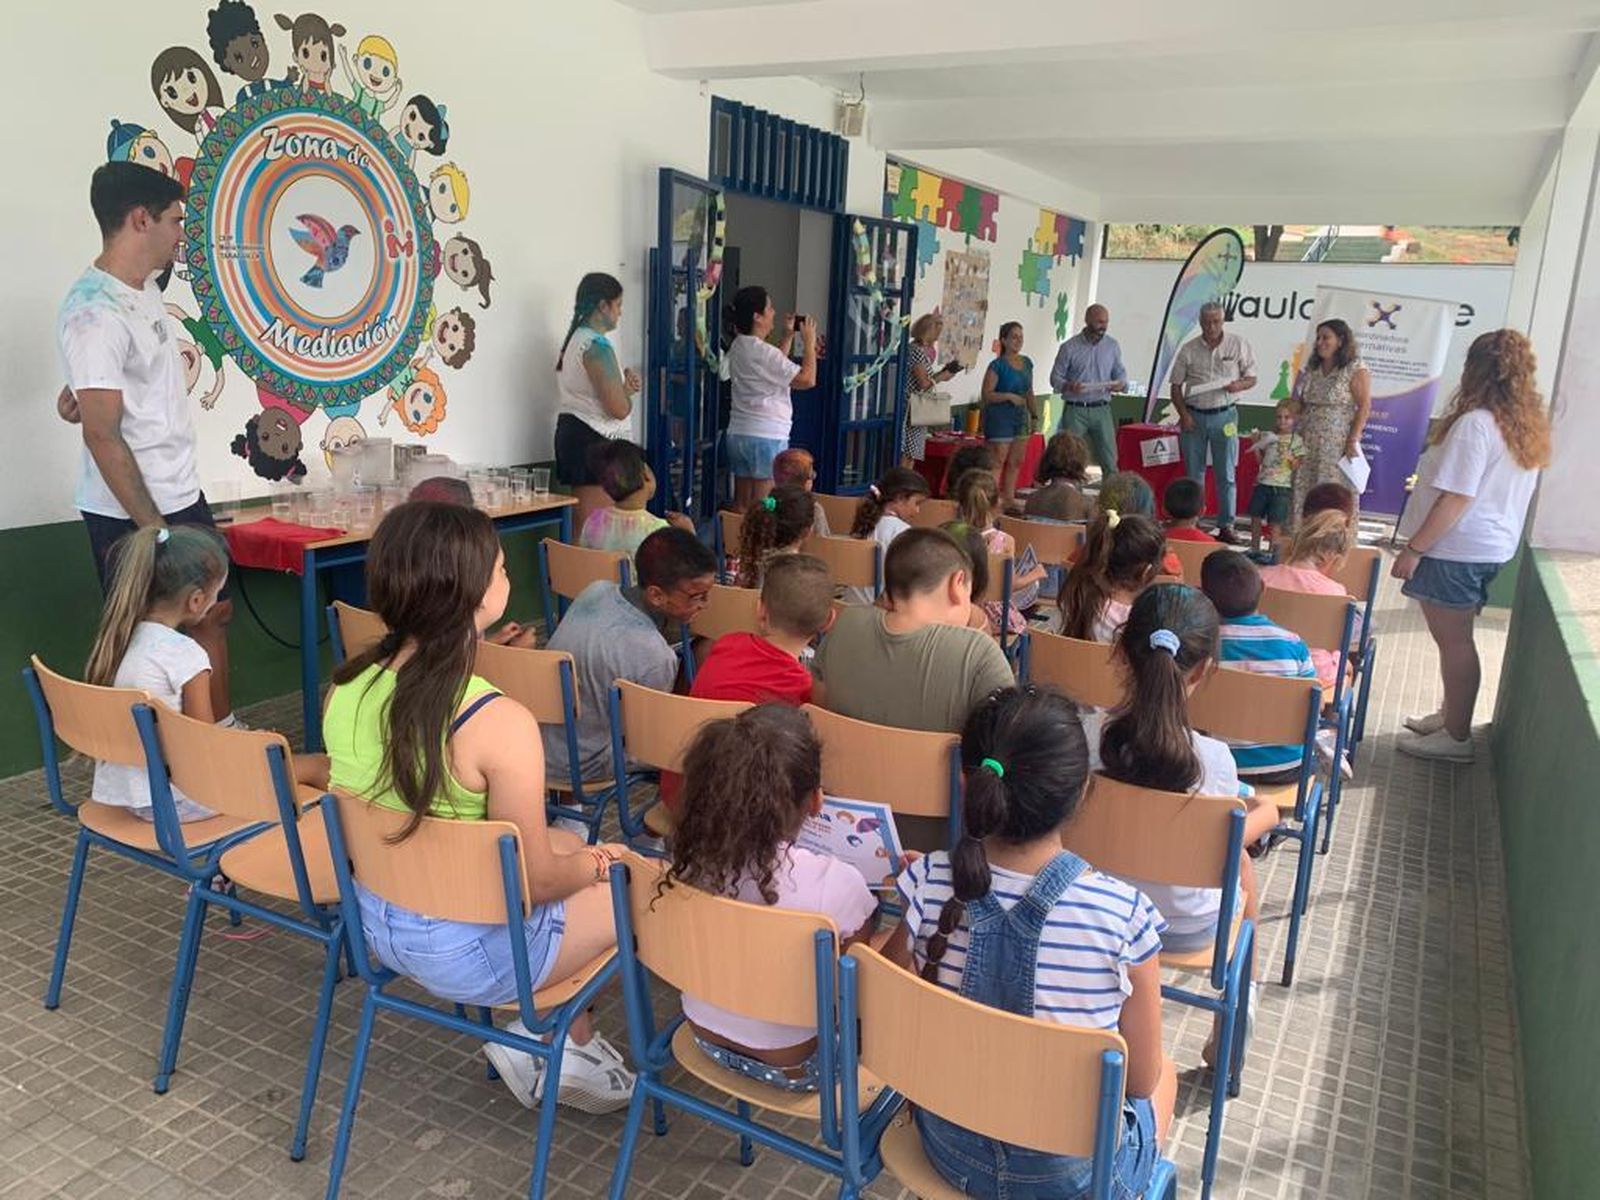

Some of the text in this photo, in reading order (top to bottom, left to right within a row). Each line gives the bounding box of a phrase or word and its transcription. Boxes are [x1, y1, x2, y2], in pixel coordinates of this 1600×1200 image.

[261, 125, 370, 168] Zona de
[259, 312, 400, 357] Mediación
